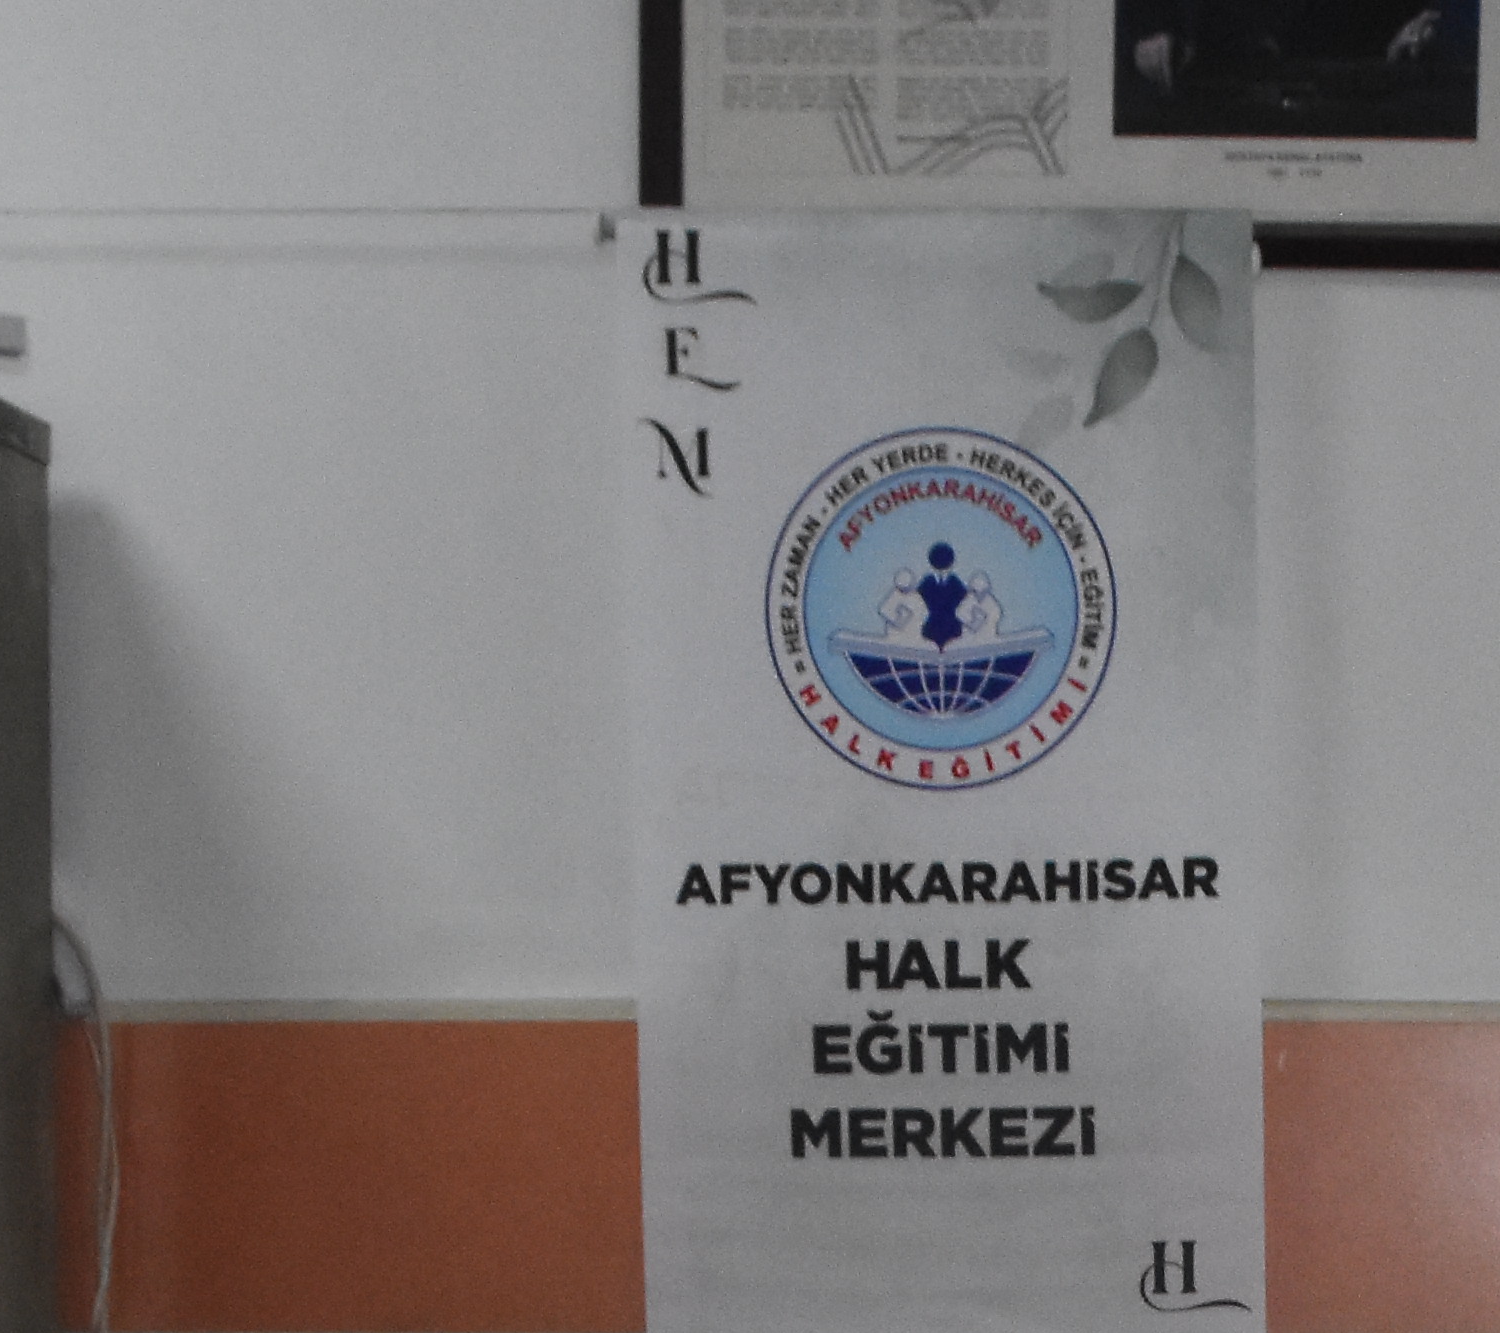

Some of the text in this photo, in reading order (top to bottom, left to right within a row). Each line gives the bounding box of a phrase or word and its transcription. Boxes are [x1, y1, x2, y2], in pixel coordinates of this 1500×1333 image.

[824, 467, 870, 506] HER
[871, 443, 949, 474] YERDE
[969, 449, 1057, 507] HERKES
[838, 478, 1045, 553] AFYONKARAHİSAR
[782, 515, 822, 597] ZAMAN
[780, 603, 802, 656] HER
[799, 683, 897, 772] HALK
[675, 857, 1221, 908] AFYONKARAHİSAR
[843, 939, 1031, 991] HALK
[811, 1007, 1071, 1076] EĞİTİMİ
[789, 1104, 1097, 1160] MERKEZİ
